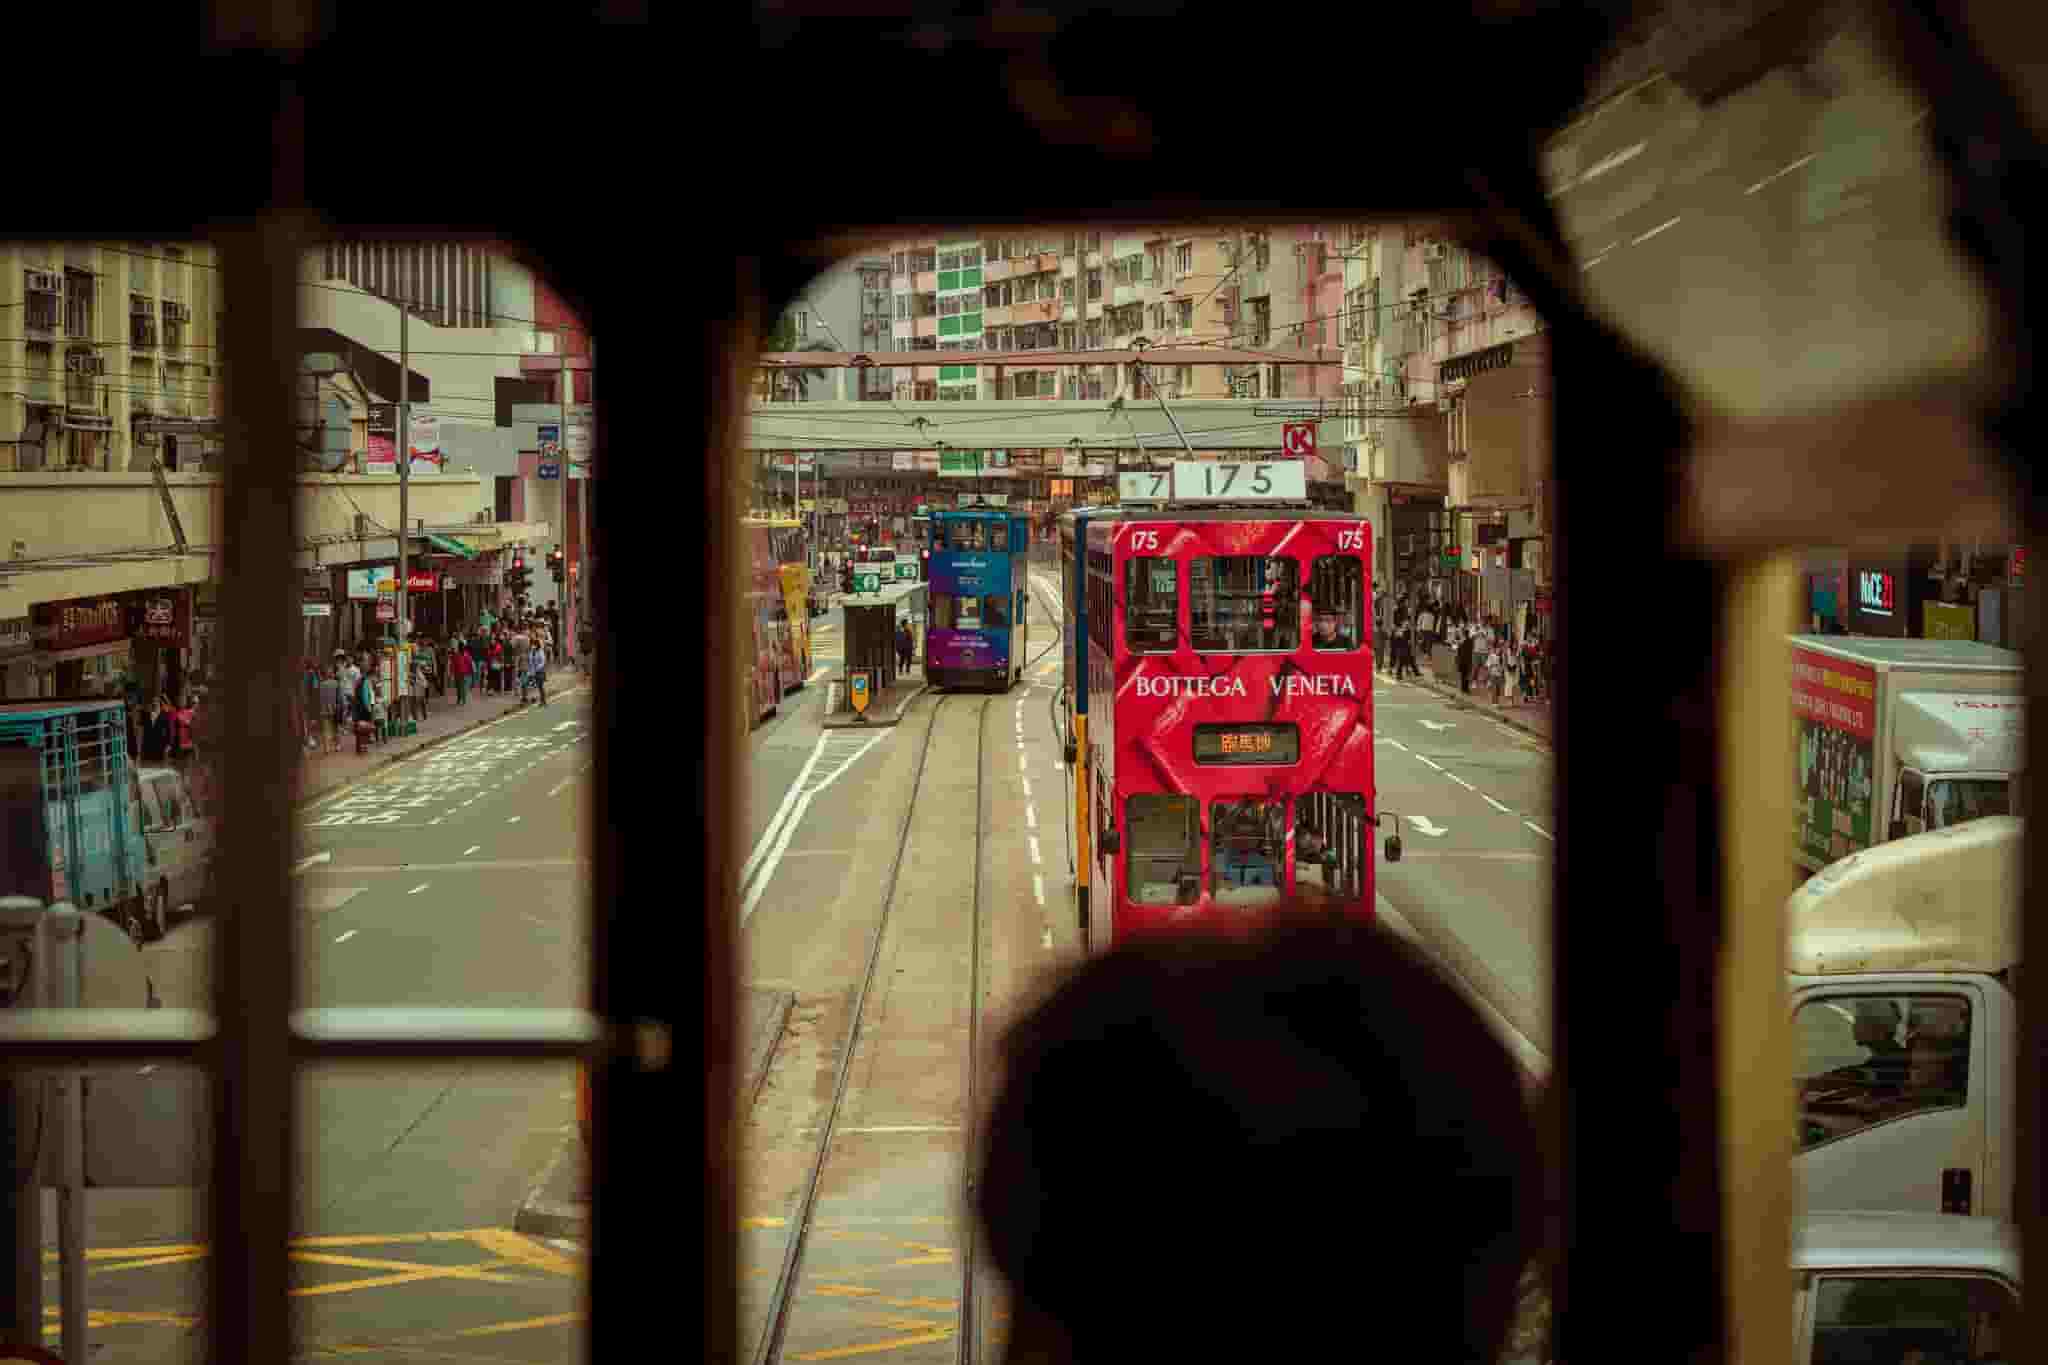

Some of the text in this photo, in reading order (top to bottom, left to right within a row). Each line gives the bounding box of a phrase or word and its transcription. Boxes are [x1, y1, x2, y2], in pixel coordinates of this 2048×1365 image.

[1203, 464, 1273, 495] 175
[1131, 530, 1159, 550] 175
[1337, 530, 1363, 550] 175
[1136, 675, 1356, 697] BOTTEGA VENETA
